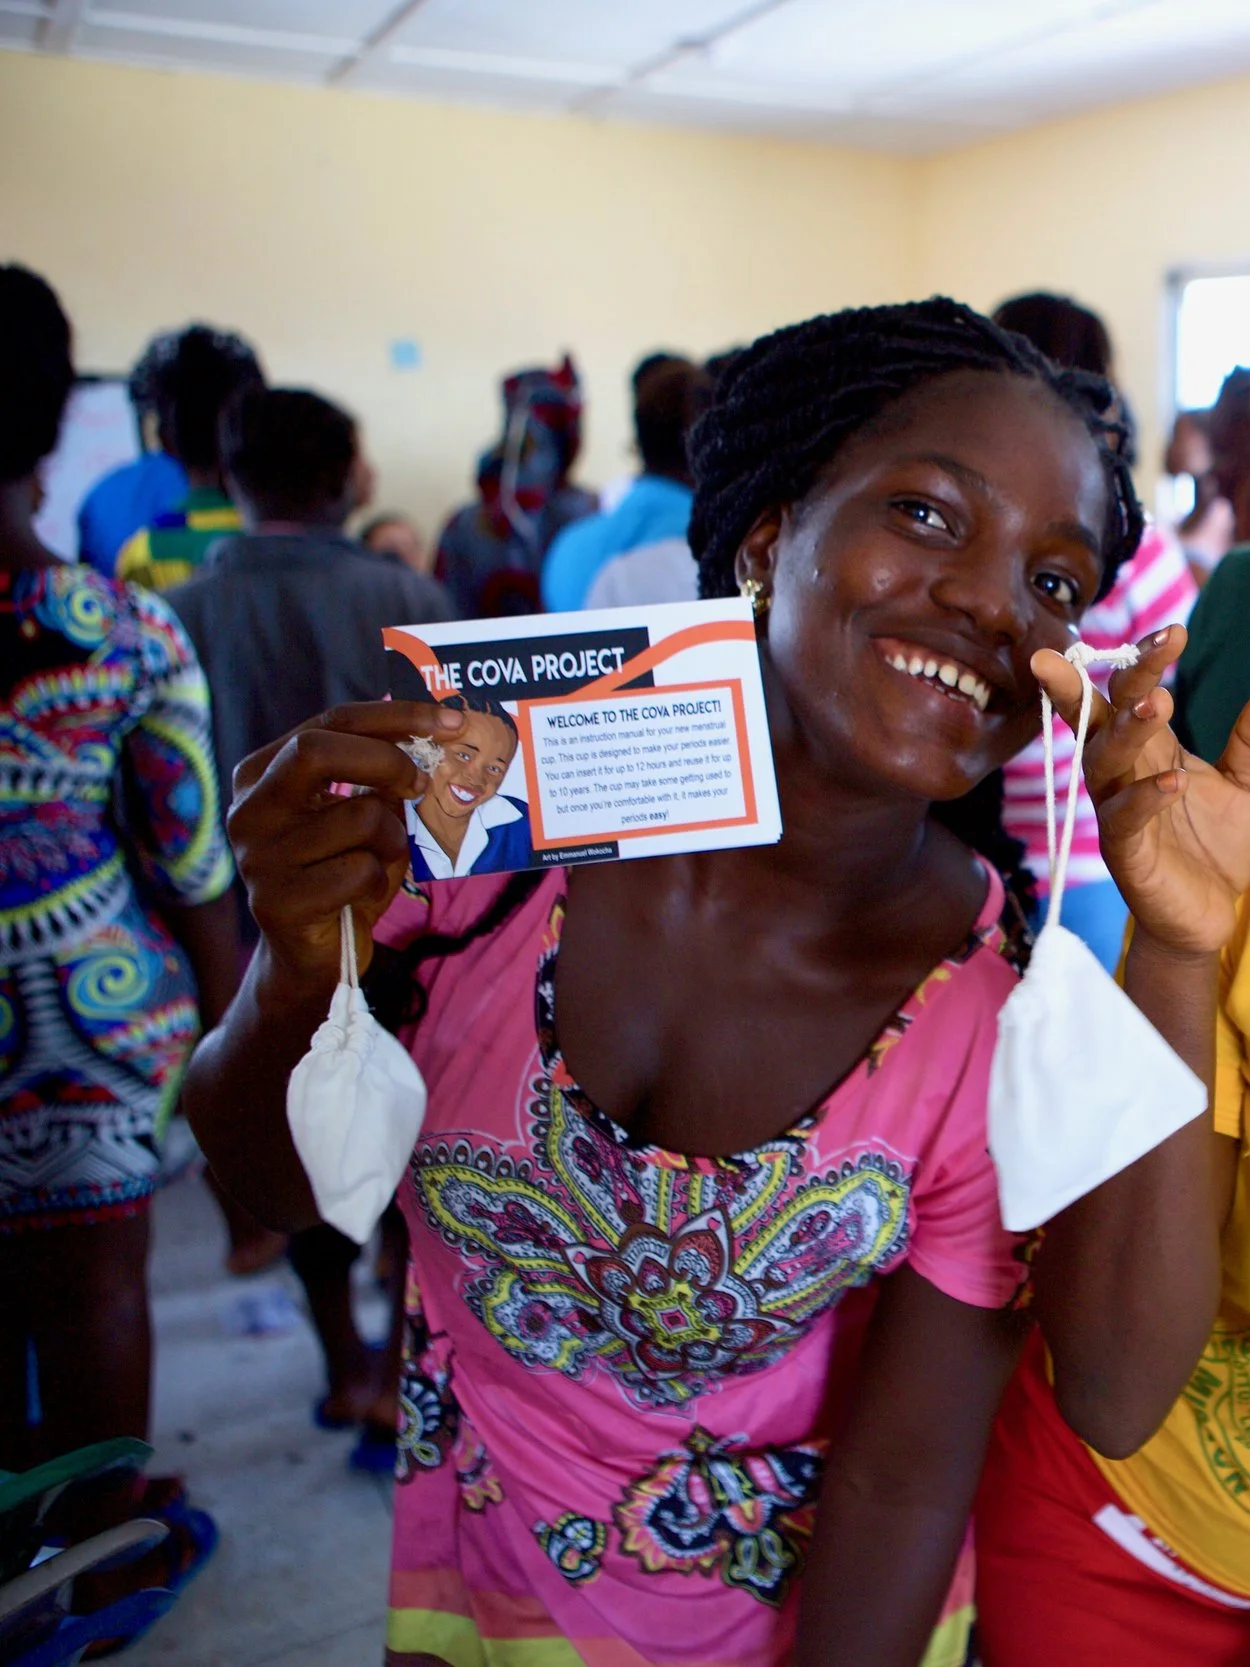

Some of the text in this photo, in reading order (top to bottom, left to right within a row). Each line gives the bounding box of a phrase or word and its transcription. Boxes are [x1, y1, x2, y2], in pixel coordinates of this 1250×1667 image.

[421, 647, 626, 691] THE COVA PROJECT
[547, 700, 722, 729] WELCOME TO THE COVA PROJECT!
[543, 720, 726, 747] This is an instruction manual for your new menstrual
[558, 752, 574, 763] This
[575, 752, 589, 762] cup
[591, 751, 598, 760] is
[599, 746, 632, 760] designed
[633, 746, 641, 755] to
[642, 744, 662, 754] make
[663, 743, 679, 753] your
[681, 739, 707, 751] periods
[544, 771, 560, 781] You
[561, 770, 575, 780] can
[576, 768, 597, 778] insert
[604, 765, 614, 775] for
[616, 765, 626, 775] up
[627, 764, 634, 773] to
[636, 761, 646, 771] 12
[646, 759, 667, 769] hours
[668, 757, 682, 767] and
[683, 756, 704, 766] reuse
[711, 754, 721, 763] for
[722, 753, 732, 763] up
[549, 789, 556, 798] to
[558, 787, 569, 797] 10
[594, 783, 608, 793] The
[609, 782, 623, 792] cup
[624, 780, 639, 790] may
[641, 776, 657, 787] take
[658, 776, 679, 785] some
[680, 773, 704, 785] getting
[705, 770, 723, 780] used
[724, 769, 732, 778] to
[556, 804, 568, 814] but
[570, 803, 589, 812] once
[589, 800, 612, 812] you're
[613, 791, 656, 808] comfortable
[657, 791, 672, 802] with
[687, 789, 711, 799] makes
[712, 787, 728, 799] your
[621, 809, 669, 824] periods easy!
[542, 853, 551, 861] Art
[551, 852, 559, 862] by
